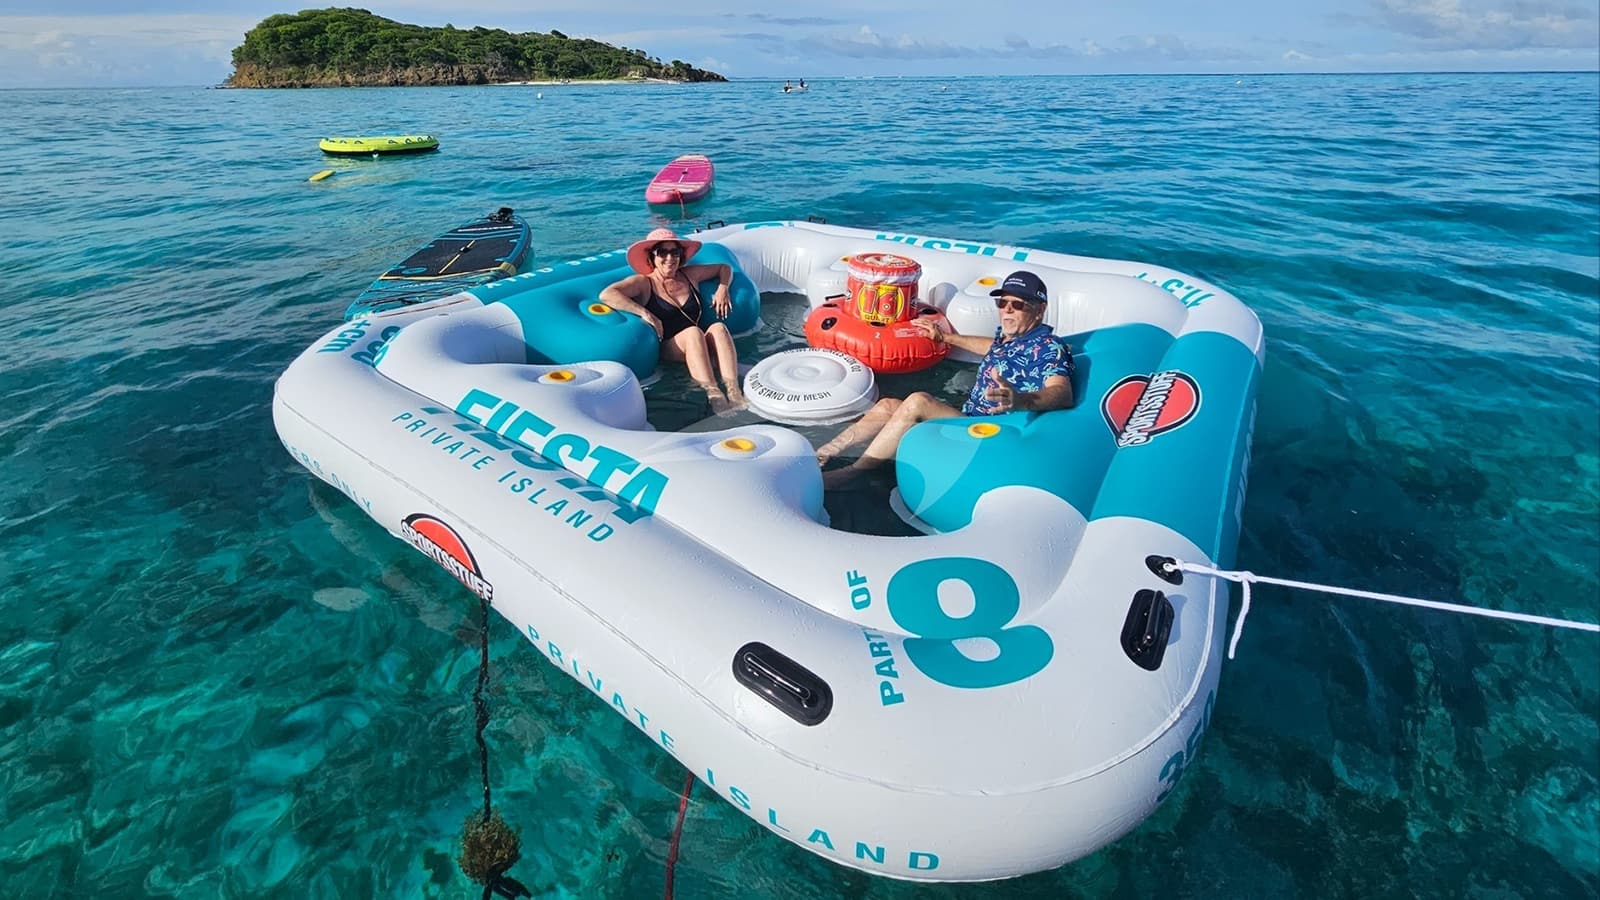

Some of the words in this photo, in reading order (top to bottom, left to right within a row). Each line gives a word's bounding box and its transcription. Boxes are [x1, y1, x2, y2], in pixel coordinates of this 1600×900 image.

[419, 388, 670, 525] FIESTA
[750, 381, 763, 392] NOT
[758, 387, 785, 401] STAND
[786, 394, 800, 402] ON
[803, 391, 832, 402] MESH
[1117, 370, 1178, 447] SPORTSSTUFF
[391, 411, 496, 471] PRIVATE
[497, 470, 615, 543] ISLAND
[846, 568, 872, 611] OF
[886, 556, 1055, 689] 8
[528, 623, 676, 755] PRIVATE
[706, 767, 940, 871] ISLAND
